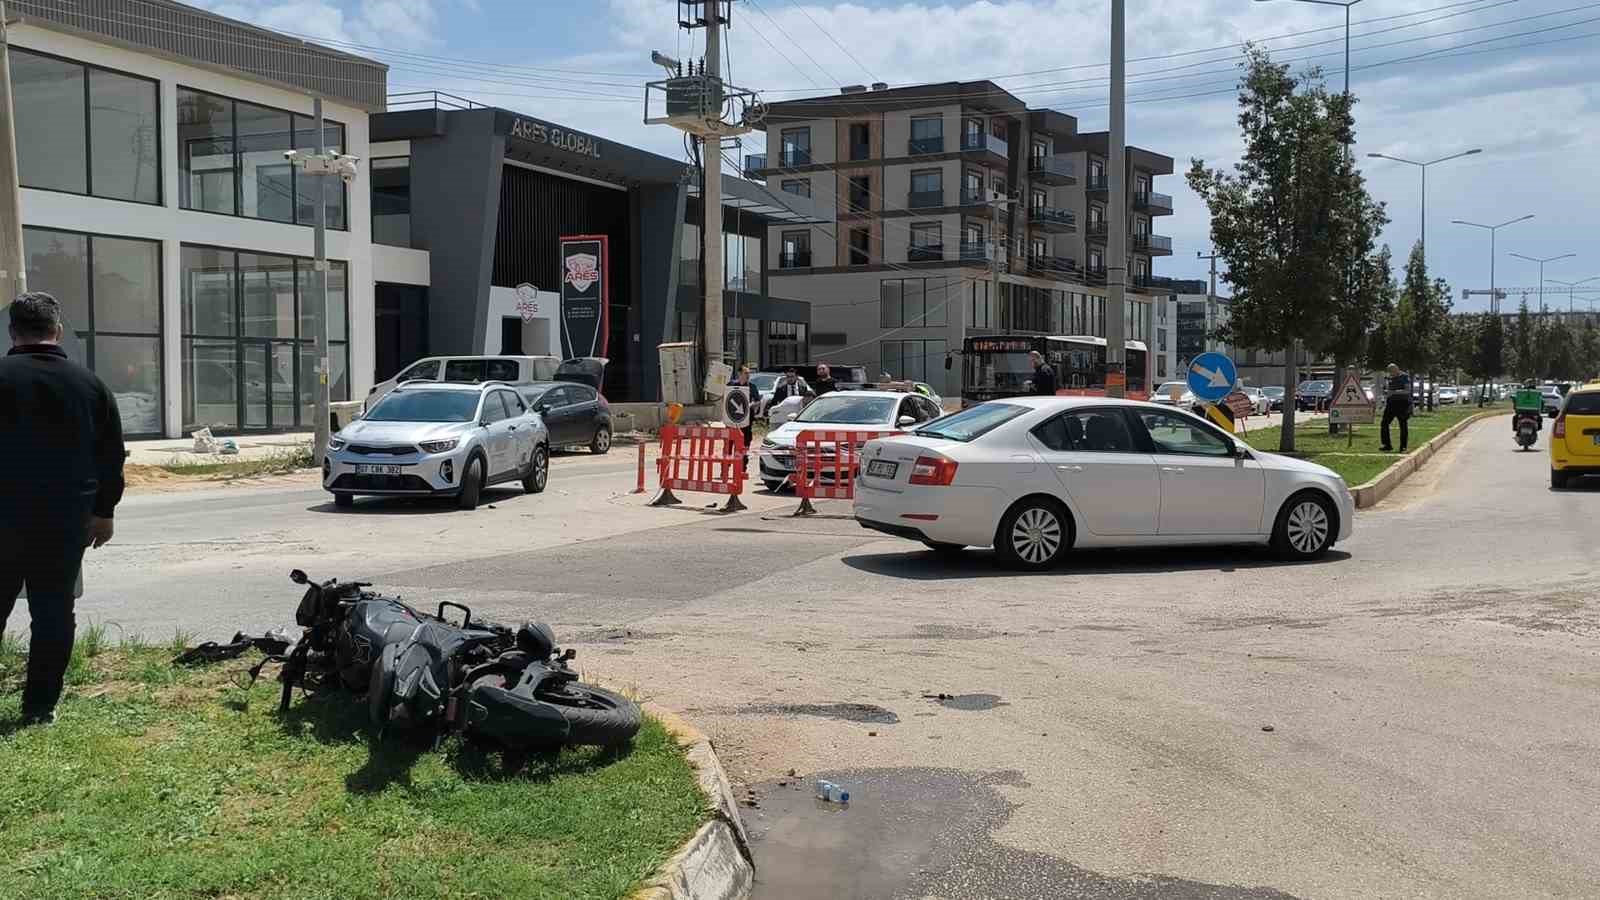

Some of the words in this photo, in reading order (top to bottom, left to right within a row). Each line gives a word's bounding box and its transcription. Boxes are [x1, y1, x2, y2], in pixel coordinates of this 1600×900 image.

[511, 118, 548, 143] ARES
[551, 128, 601, 158] GLOBAL
[564, 270, 599, 283] ARES
[516, 302, 539, 313] ARES
